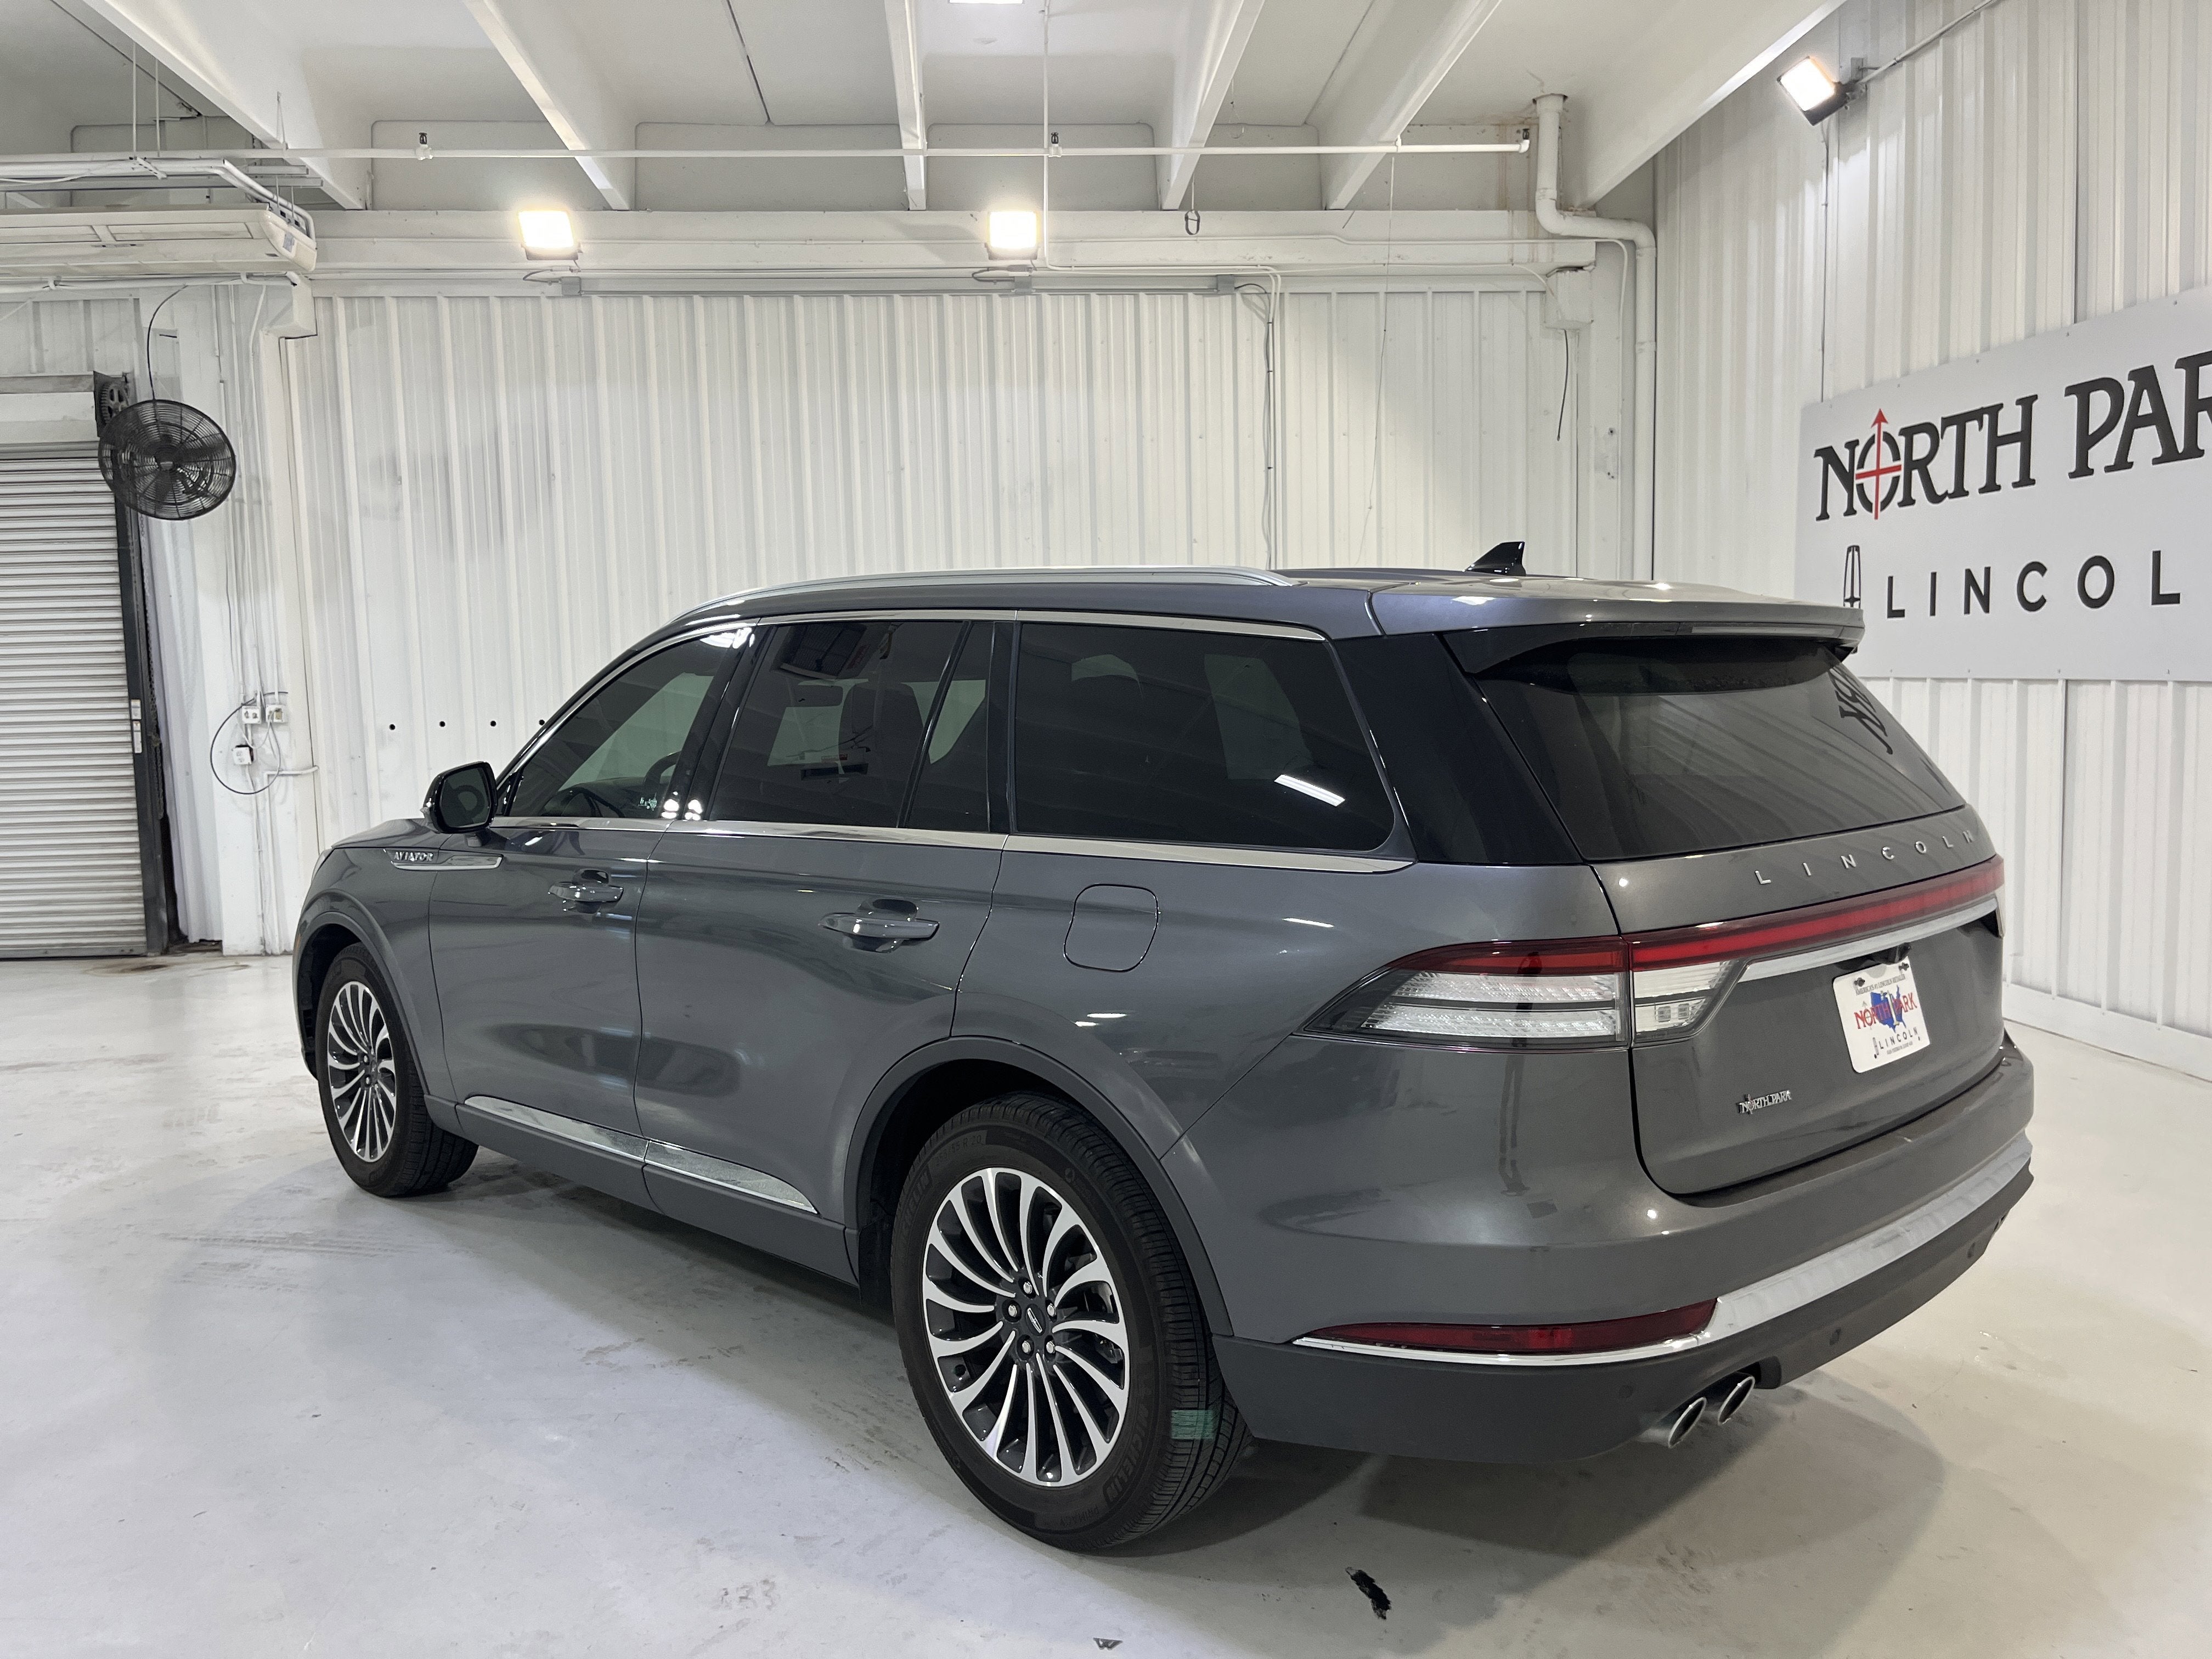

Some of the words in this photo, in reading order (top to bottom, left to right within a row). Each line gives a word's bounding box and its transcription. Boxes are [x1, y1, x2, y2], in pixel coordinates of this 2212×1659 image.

[1813, 394, 2039, 521] NORTH
[1886, 550, 2181, 619] LINCOL
[394, 851, 433, 862] AVIATOR
[1754, 829, 1976, 885] LINCOLN
[1854, 1002, 1892, 1029] NORTH
[1892, 992, 1917, 1015] PARK
[1878, 1026, 1918, 1049] LINCOLN
[1739, 1094, 1770, 1114] NORTH
[1770, 1090, 1792, 1104] PARK
[1107, 1404, 1149, 1503] MICHELIN
